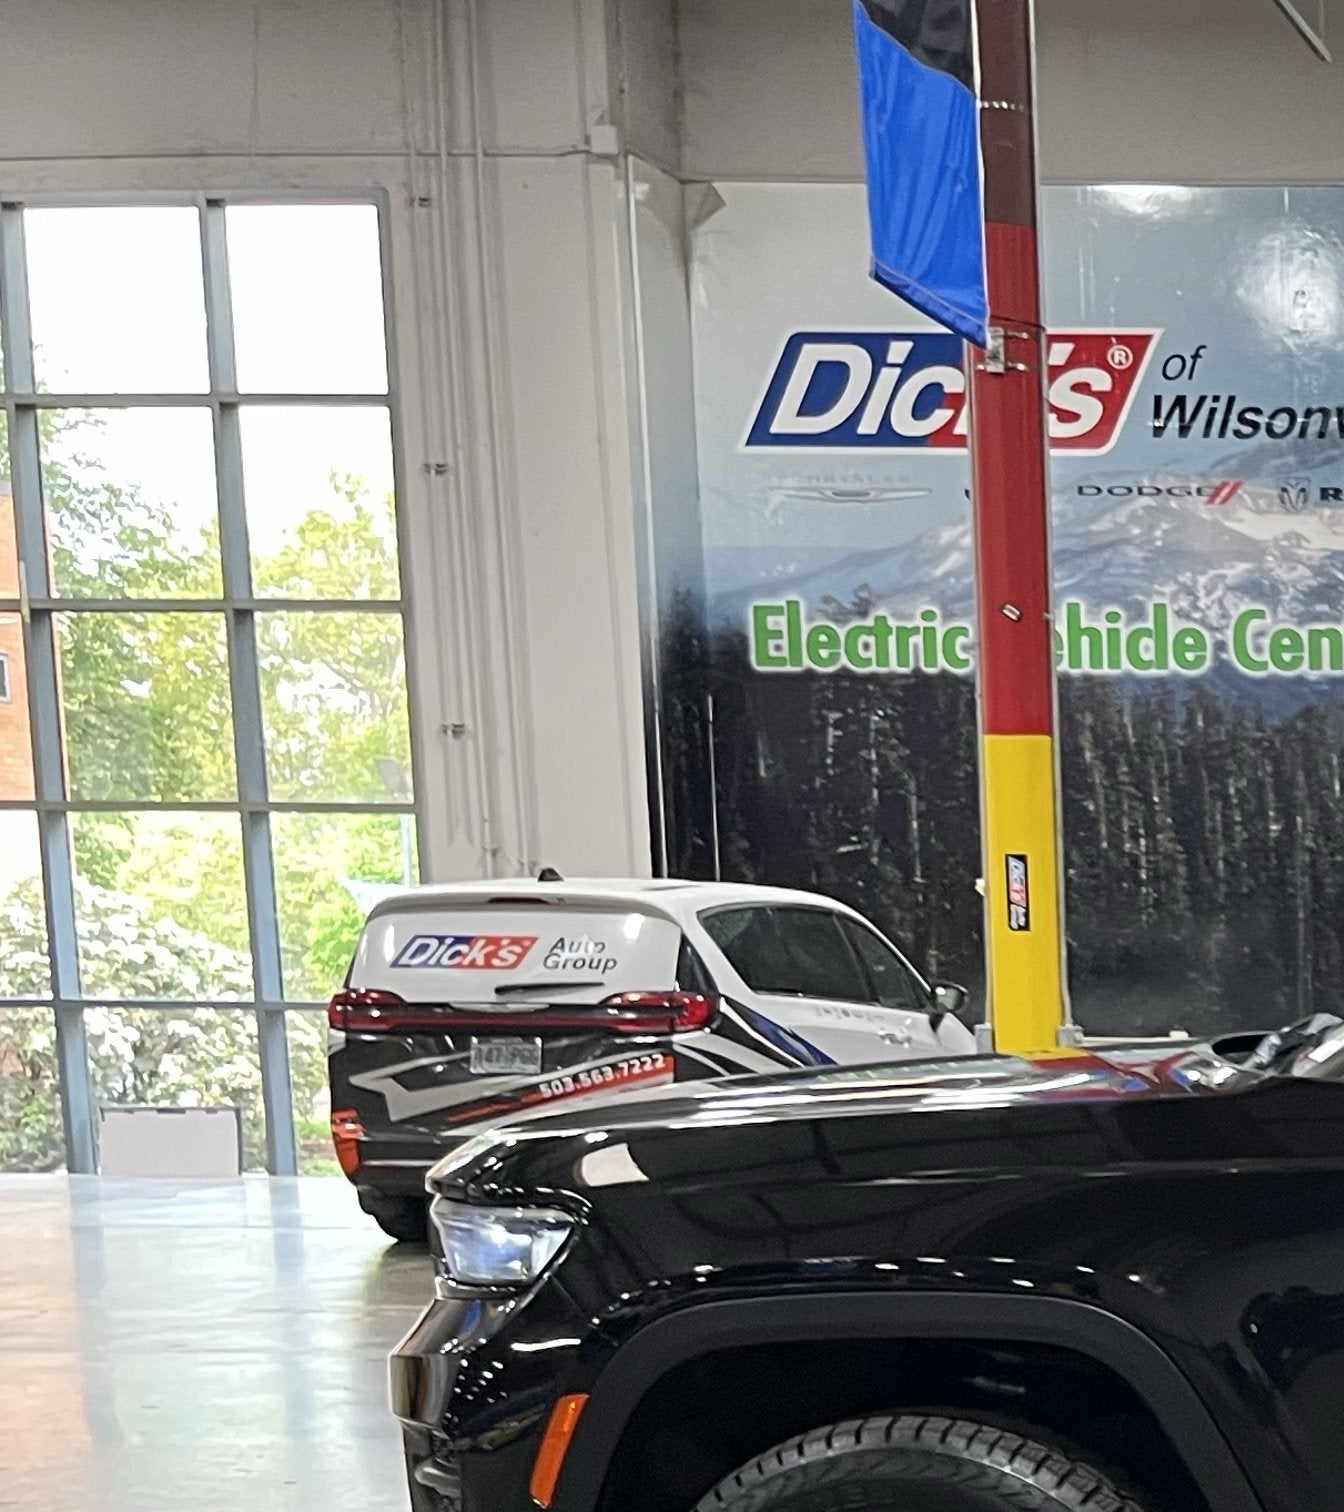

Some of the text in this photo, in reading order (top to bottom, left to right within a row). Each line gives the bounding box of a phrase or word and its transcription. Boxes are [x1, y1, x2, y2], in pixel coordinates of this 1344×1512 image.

[1161, 345, 1206, 381] of
[769, 340, 1113, 438] Dic's
[1077, 485, 1216, 496] DODGE
[754, 600, 970, 670] Electric
[1053, 601, 1205, 671] hicle
[398, 937, 523, 967] Dick's
[550, 936, 606, 954] Auto
[543, 952, 618, 975] Group
[539, 1053, 667, 1098] 503.563.7222
